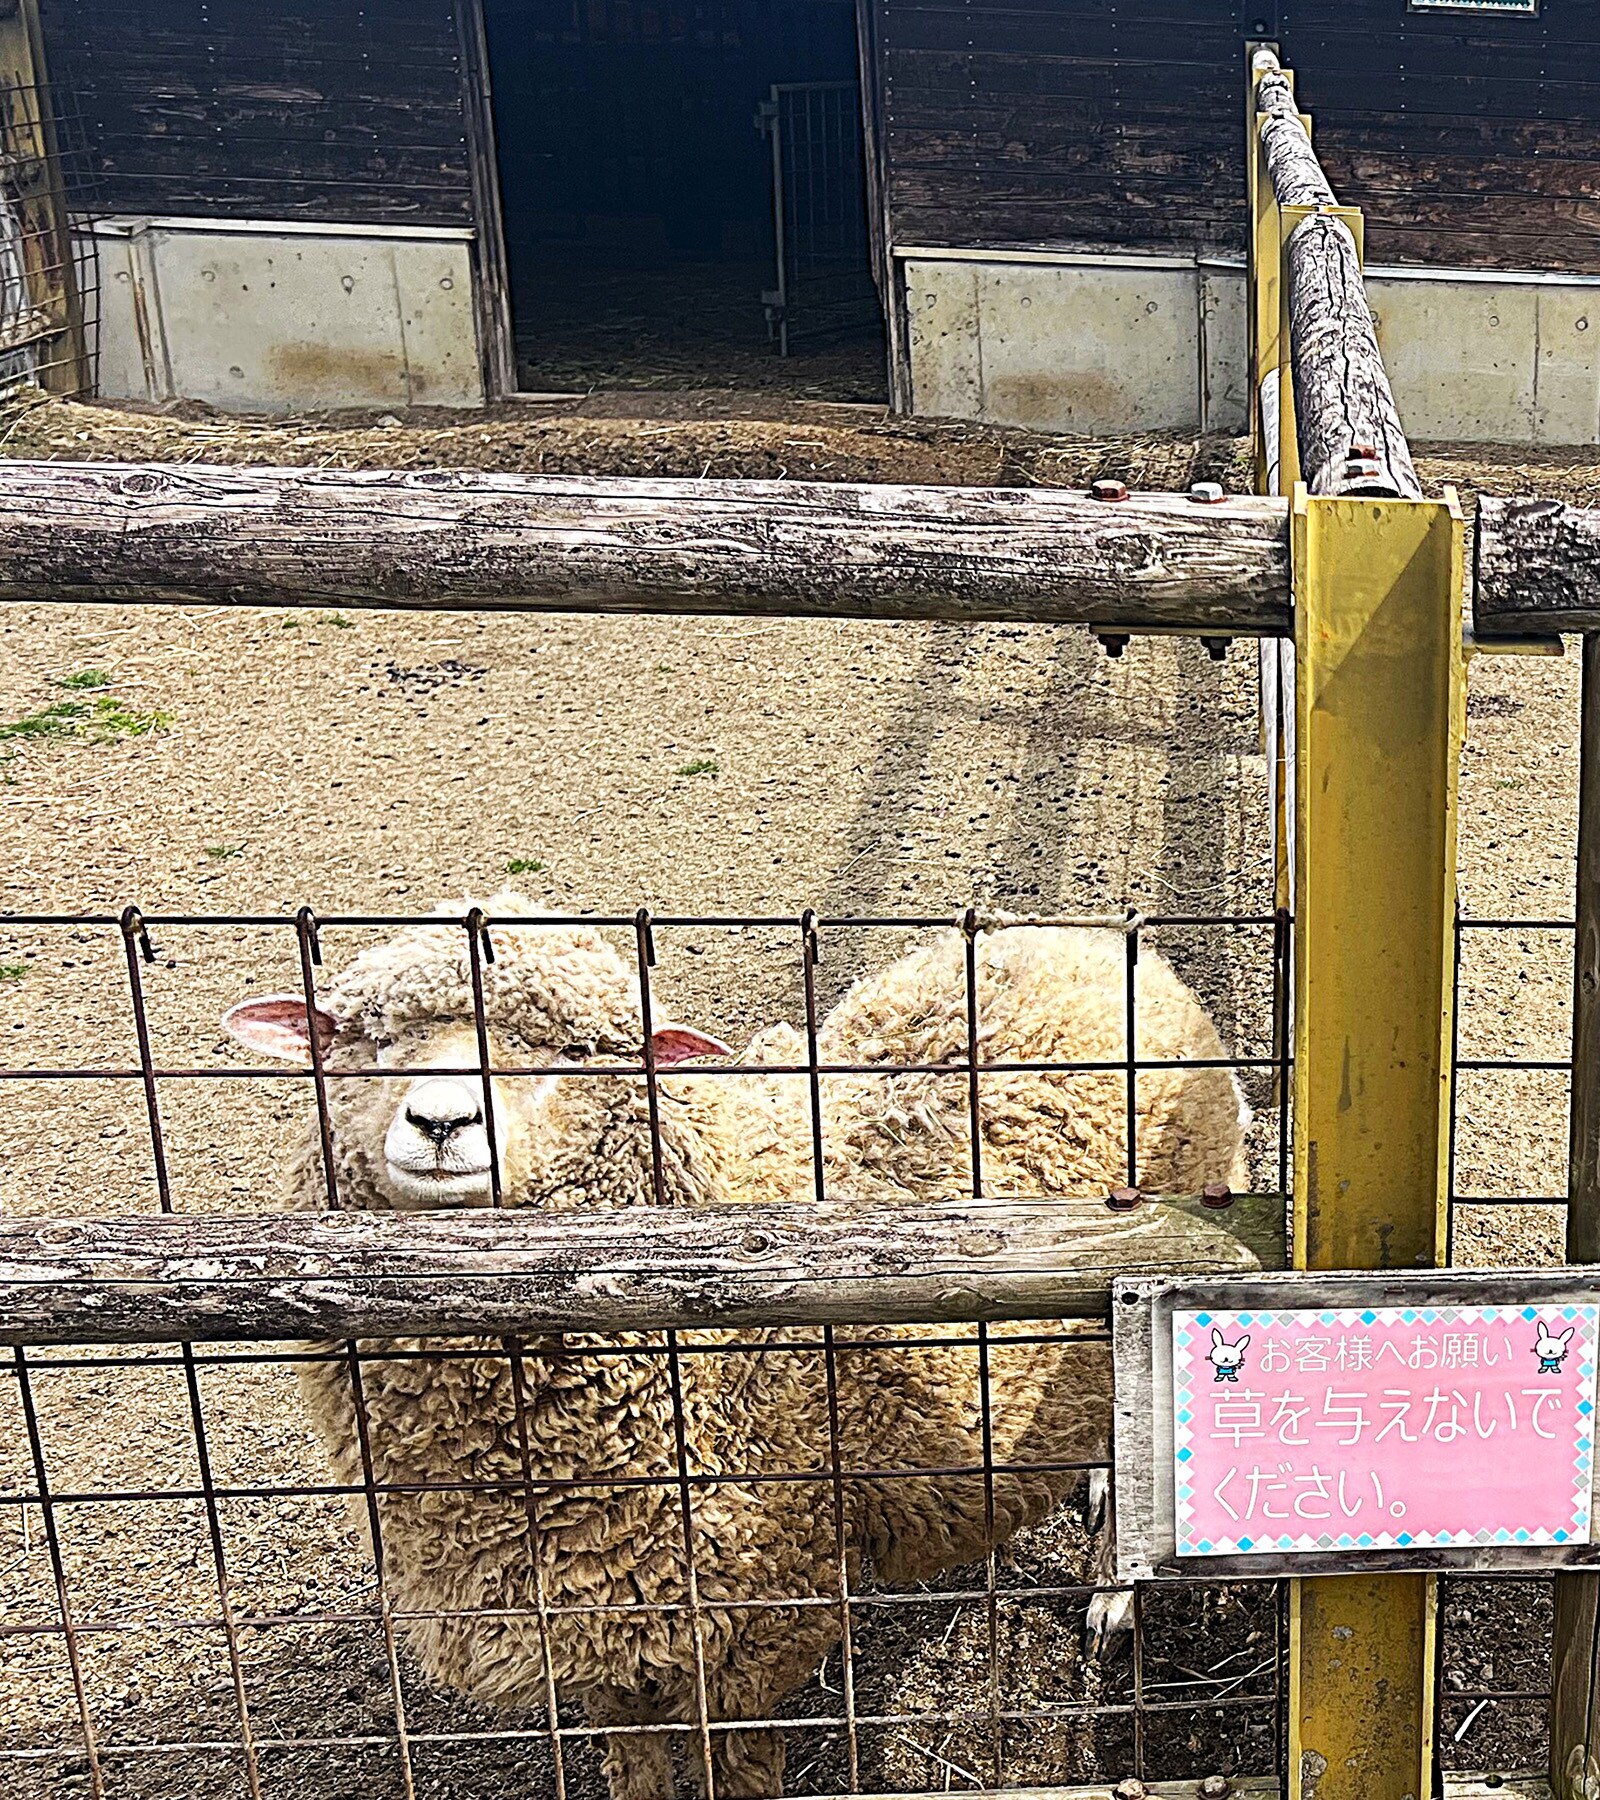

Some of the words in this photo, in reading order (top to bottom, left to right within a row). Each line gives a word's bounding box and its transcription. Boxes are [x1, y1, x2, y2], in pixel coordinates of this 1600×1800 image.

[1260, 1333, 1513, 1373] お客様へお願い
[1209, 1386, 1563, 1448] 草を与えないで
[1213, 1462, 1408, 1521] ください。
